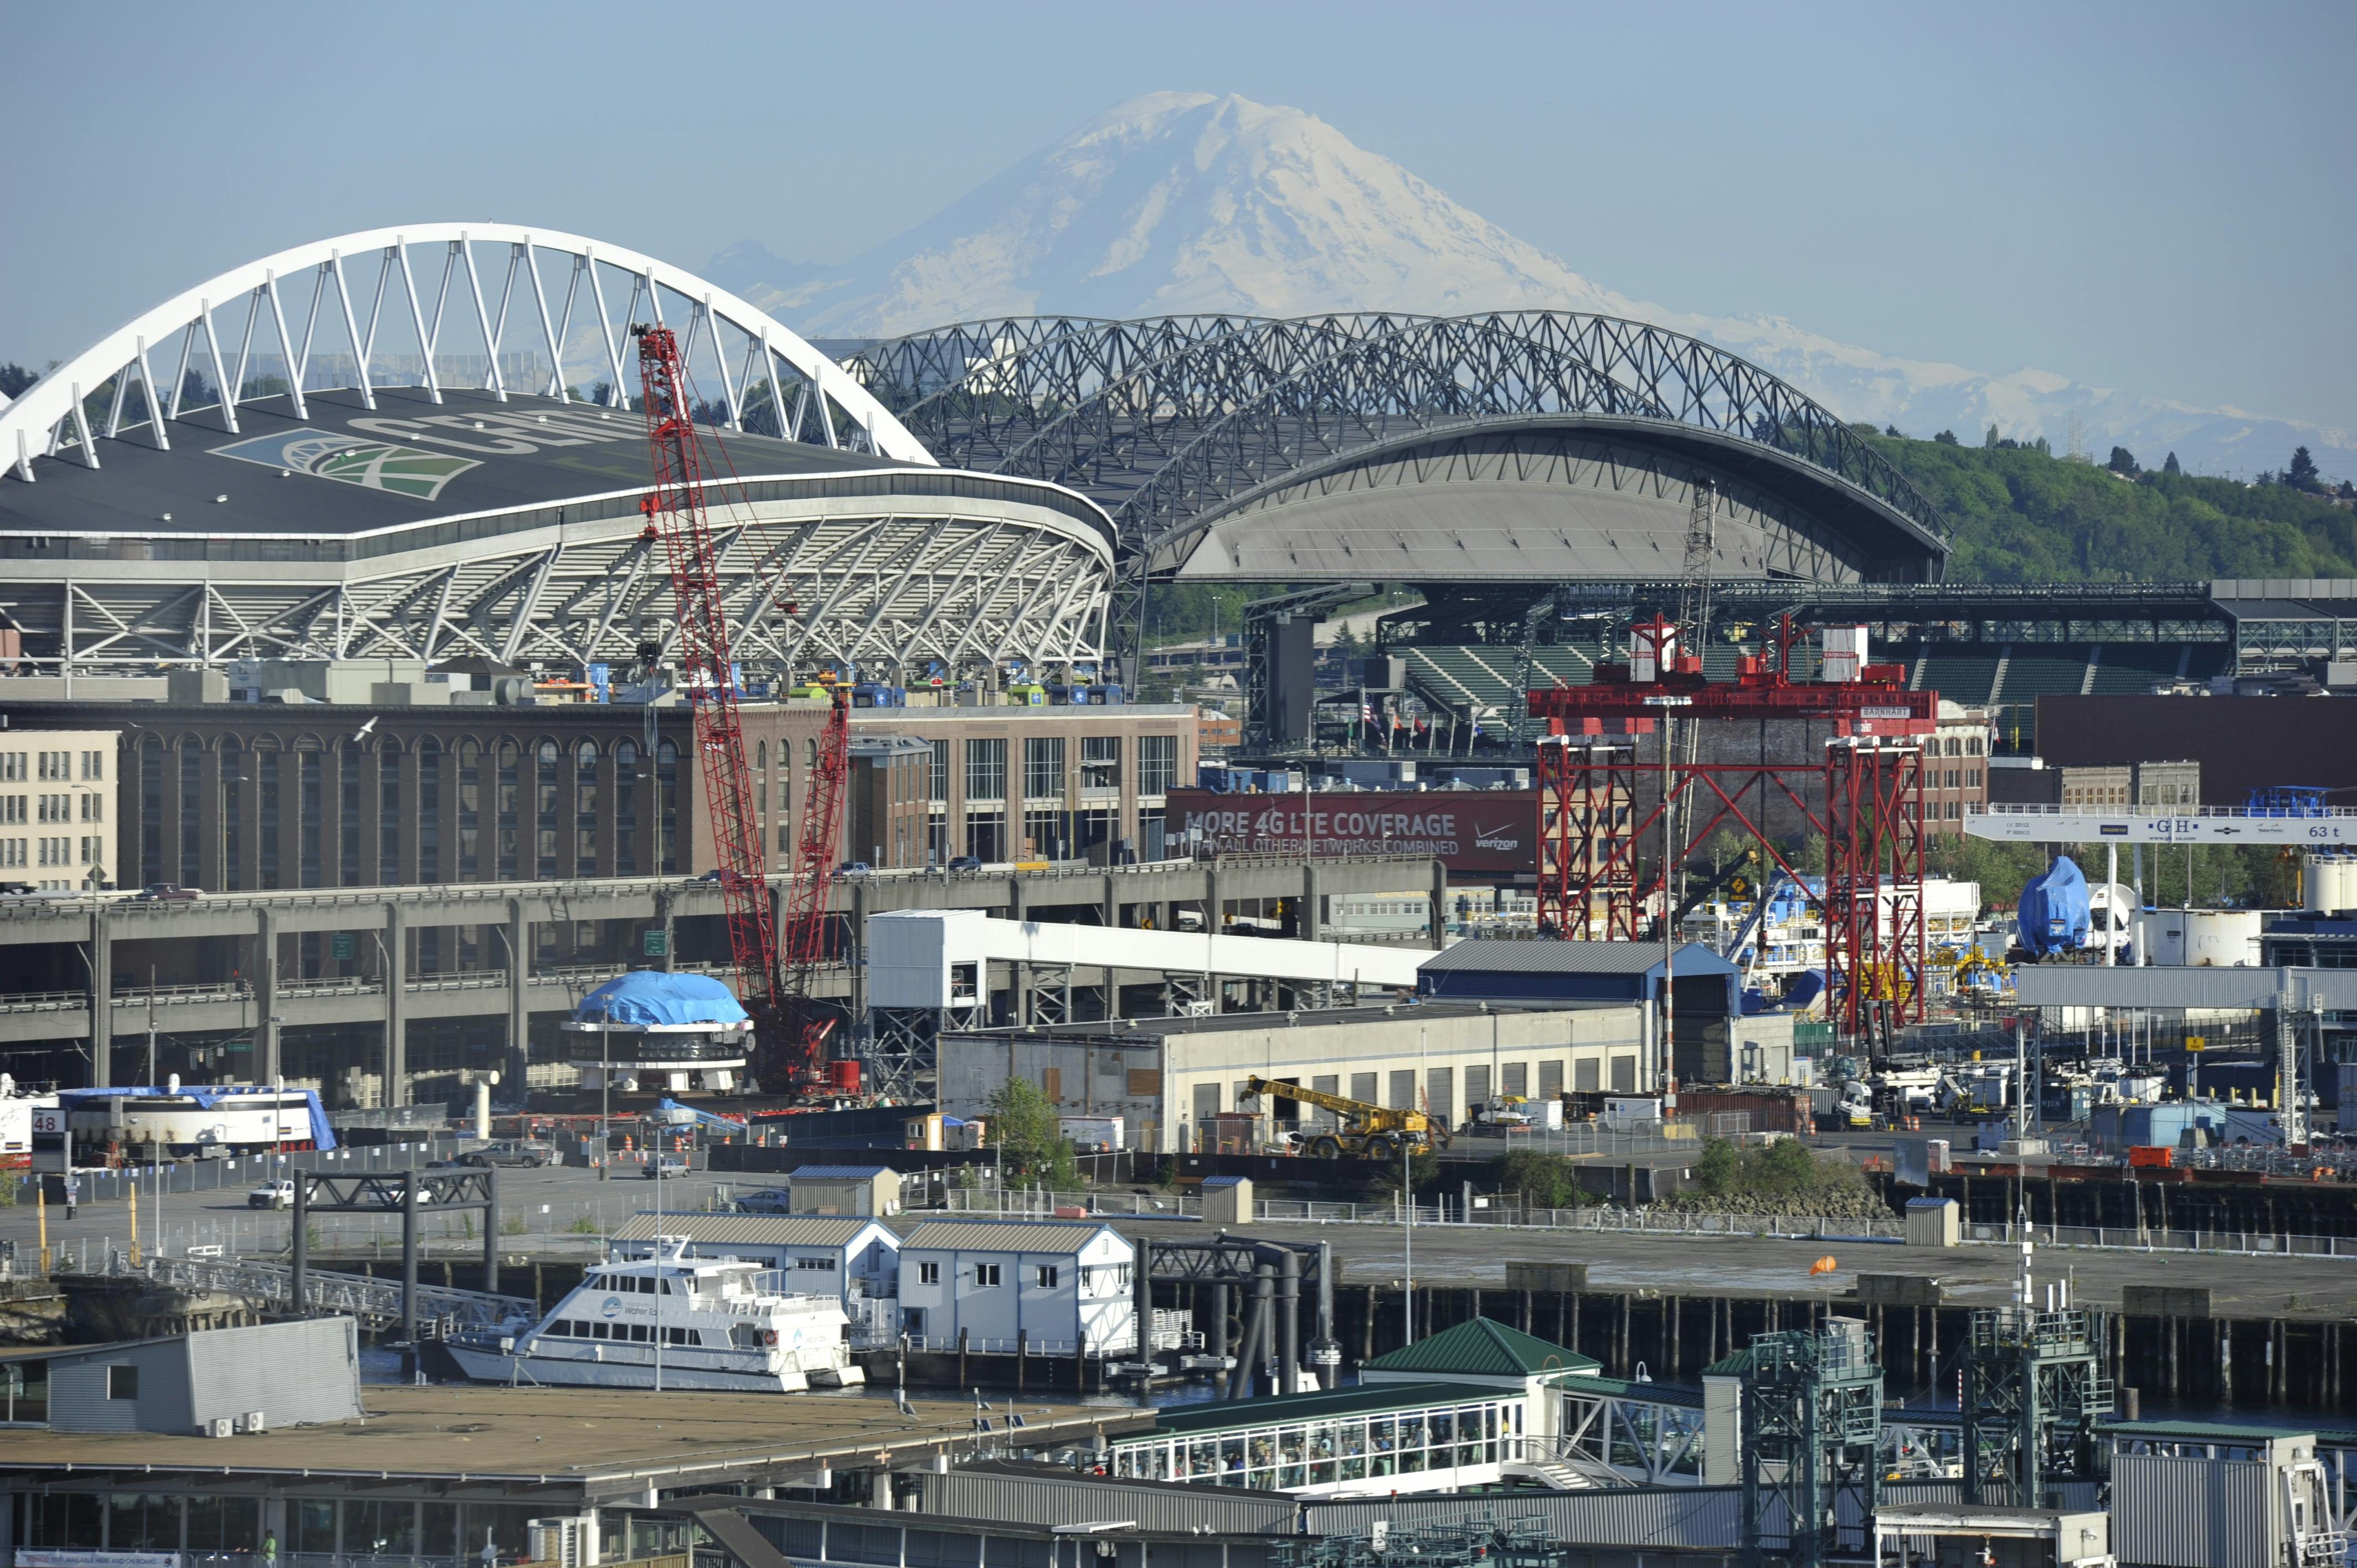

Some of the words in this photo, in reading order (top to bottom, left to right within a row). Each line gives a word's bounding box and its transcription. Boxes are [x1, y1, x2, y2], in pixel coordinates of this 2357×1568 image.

[596, 667, 608, 685] 20
[1185, 811, 1249, 834] MORE
[1254, 812, 1285, 834] 4G
[1290, 812, 1328, 835] LTE
[1332, 813, 1457, 837] COVERAGE
[2309, 826, 2328, 838] 63
[2333, 827, 2340, 838] t
[1224, 838, 1249, 852] ALL
[1253, 838, 1299, 852] OTHER
[1302, 839, 1381, 853] NETWORKS
[1384, 840, 1459, 855] COMBINED
[1475, 837, 1517, 850] verizon
[34, 1117, 55, 1131] 48
[625, 1306, 647, 1316] Water
[649, 1308, 665, 1316] Tai
